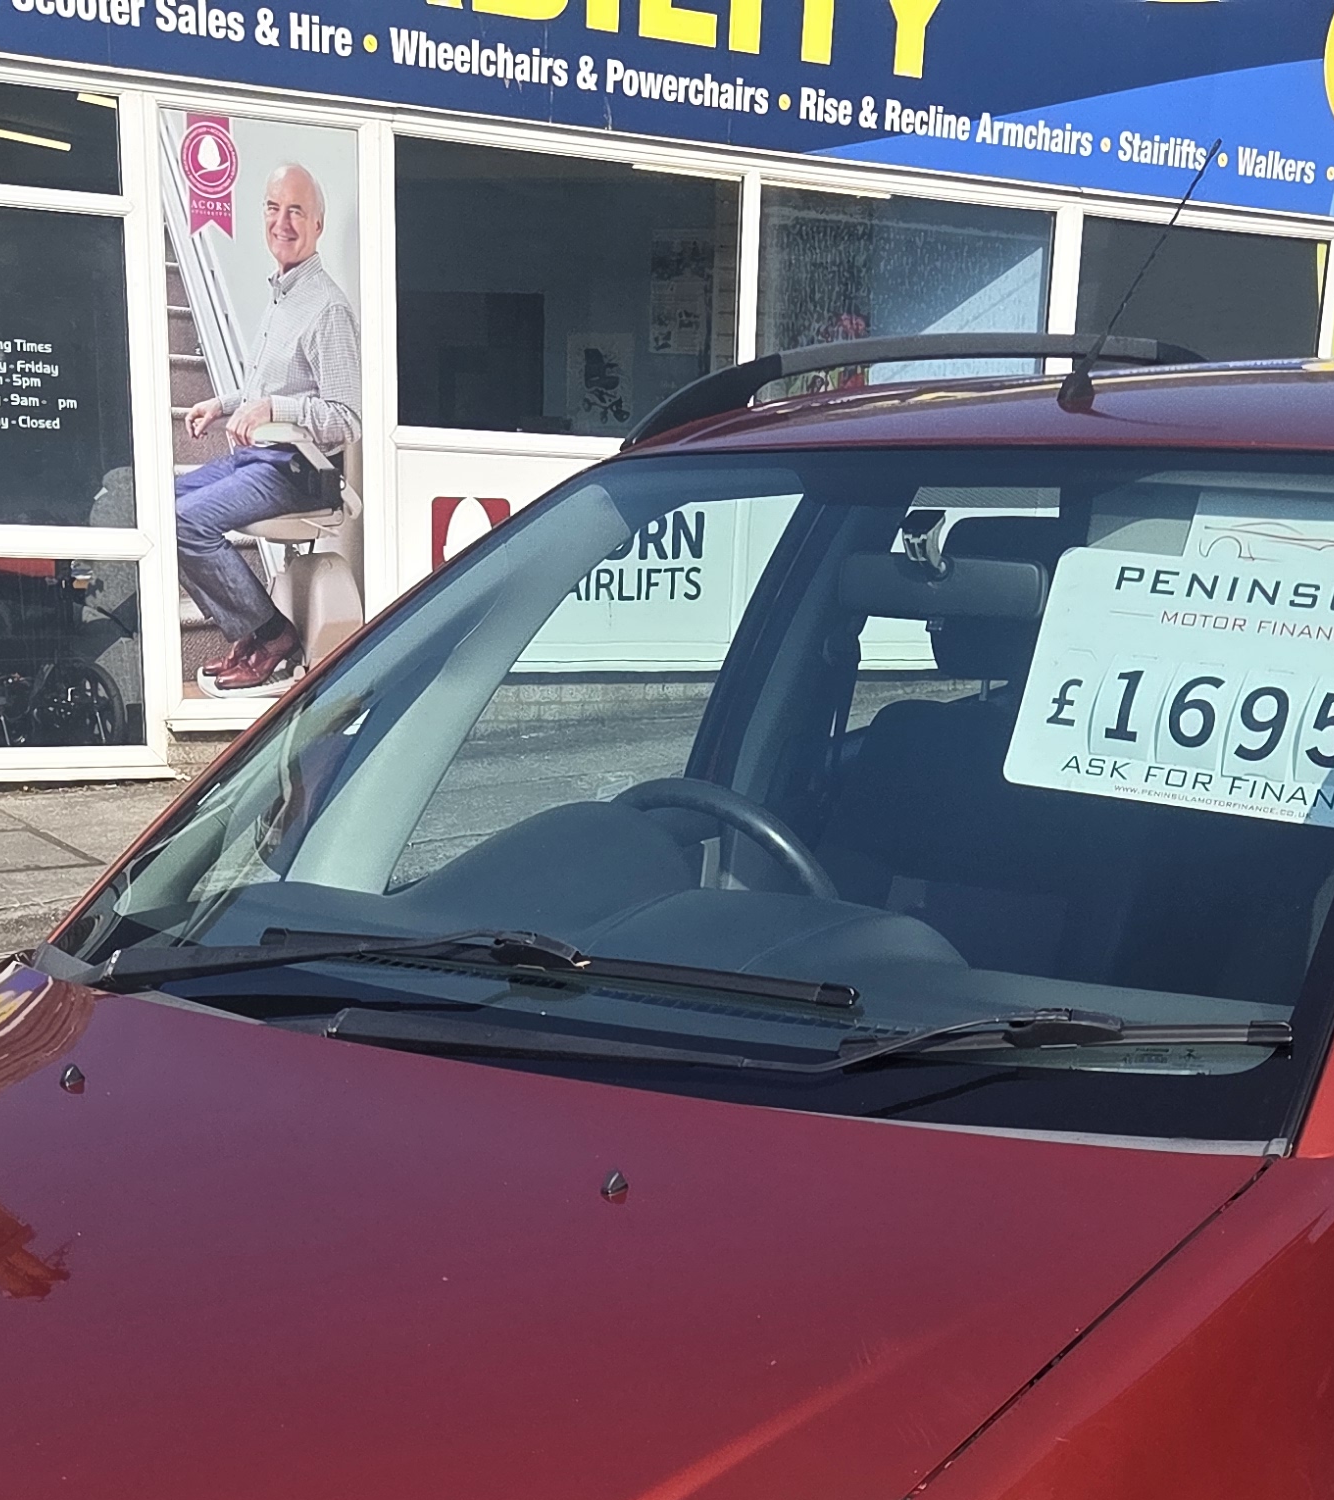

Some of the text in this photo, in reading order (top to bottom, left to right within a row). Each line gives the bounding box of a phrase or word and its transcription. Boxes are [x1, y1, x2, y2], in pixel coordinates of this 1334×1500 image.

[156, 0, 245, 42] Sales
[255, 13, 280, 47] &
[289, 13, 353, 57] Hire
[389, 27, 569, 87] Wheelchairs
[576, 55, 598, 91] &
[605, 60, 769, 115] Powerchairs
[799, 87, 853, 126] Rise
[858, 95, 879, 129] &
[884, 98, 971, 141] Recline
[975, 112, 1093, 157] Armchairs
[1117, 131, 1207, 171] Stairlifts
[1238, 146, 1316, 184] Walkers
[190, 199, 231, 212] ACORN
[14, 339, 53, 354] Times
[17, 360, 59, 377] Friday
[12, 374, 42, 389] 5pm
[10, 393, 40, 407] 9am
[58, 398, 78, 410] pm
[18, 416, 61, 429] Closed
[1160, 610, 1247, 633] MOTOR
[1061, 755, 1131, 781] ASK
[1144, 766, 1214, 792] FOR
